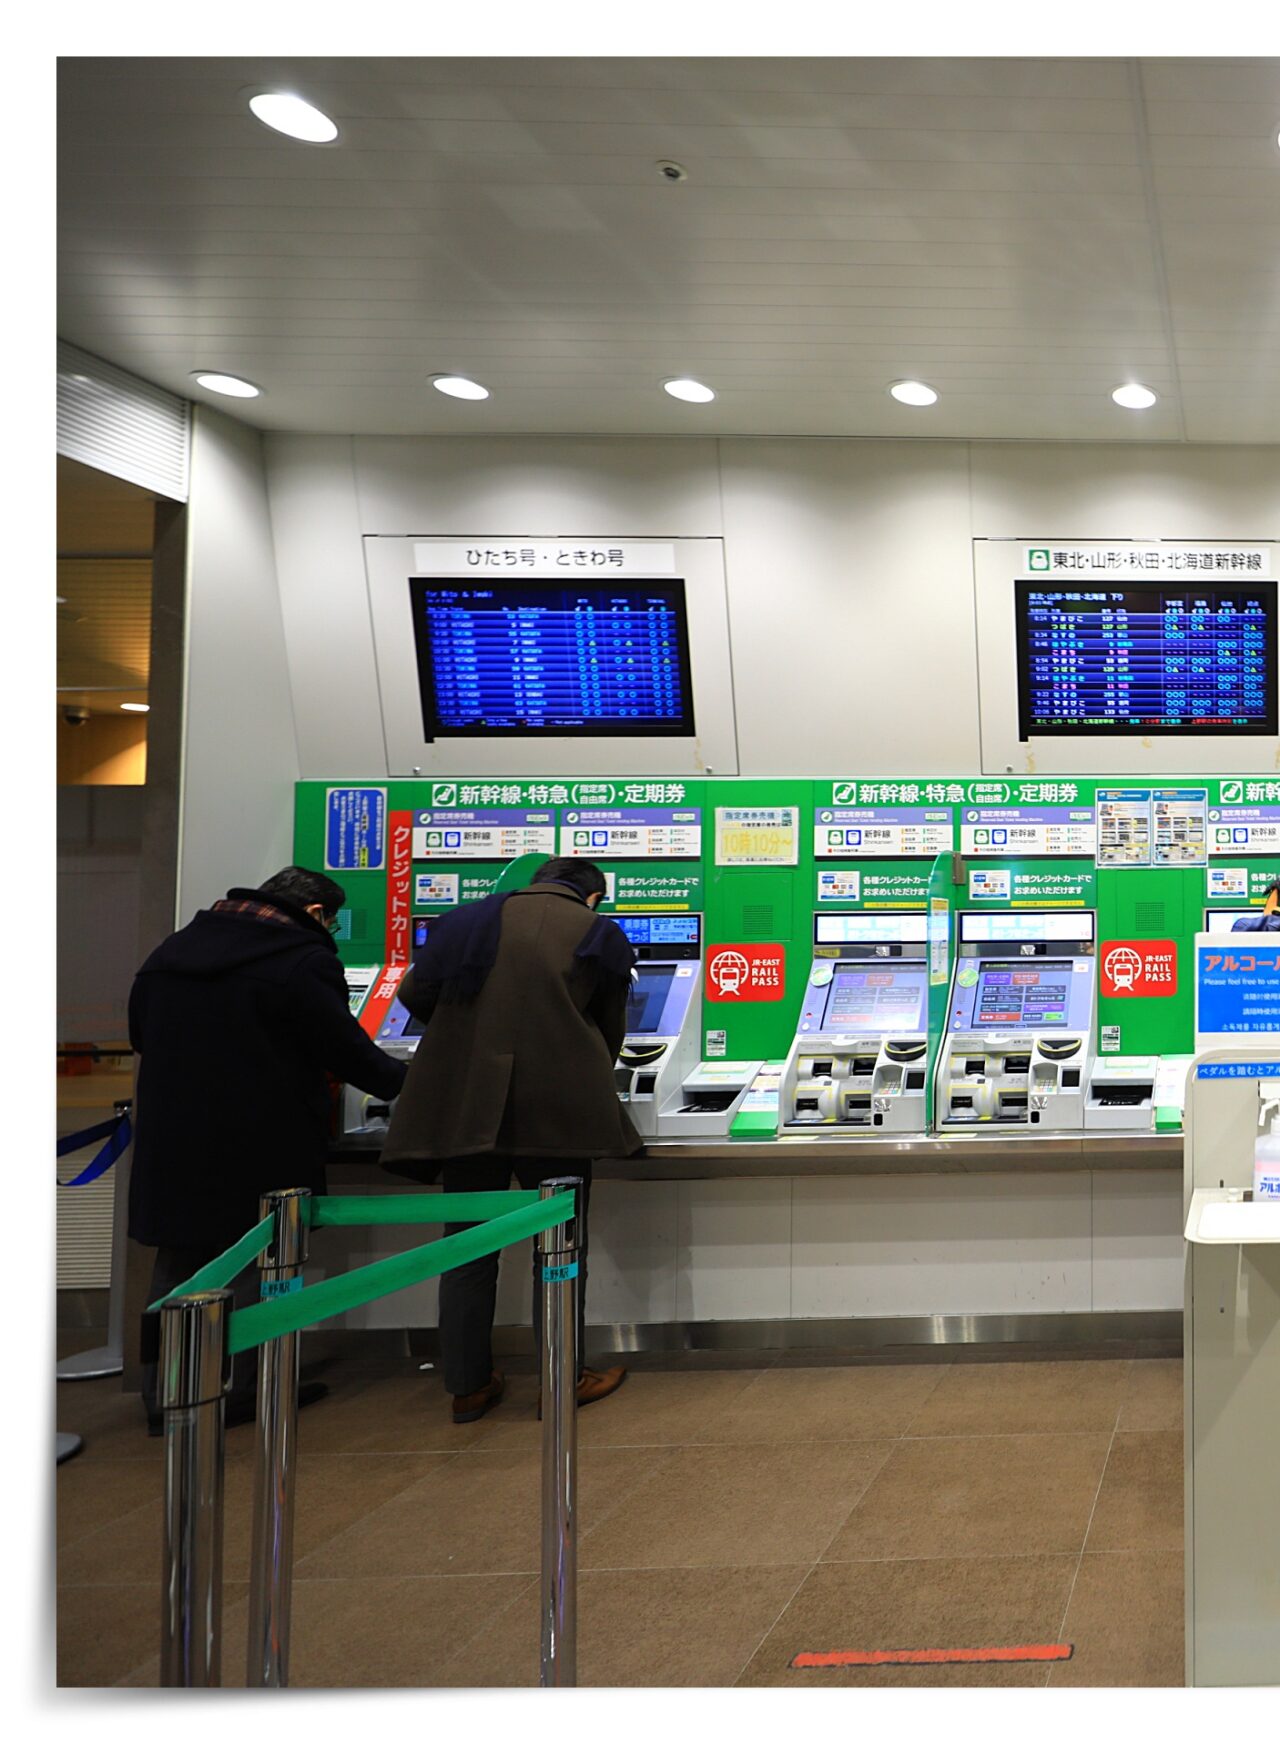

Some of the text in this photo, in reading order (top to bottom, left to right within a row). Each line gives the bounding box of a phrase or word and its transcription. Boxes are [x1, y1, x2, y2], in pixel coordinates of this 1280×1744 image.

[466, 549, 625, 567] ひたち号・ときわ号
[1053, 550, 1262, 571] 東北・山形・秋田・北海道新幹線
[579, 784, 608, 794] 指定席
[975, 783, 1003, 793] 指定席
[579, 795, 608, 804] 自由席
[975, 794, 1003, 803] 自由席
[464, 832, 490, 840] 新幹線
[611, 830, 638, 840] 新幹線
[864, 830, 891, 838] 新幹線
[1010, 828, 1036, 838] 新幹線
[1250, 828, 1276, 836] 新幹線
[618, 877, 700, 886] 各種クレジットカードで
[863, 876, 930, 885] 各種クレジットカー
[1014, 874, 1092, 883] 各種クレジットカードで
[618, 888, 689, 898] お求めいただけます
[1014, 886, 1082, 894] お求めいただけます
[374, 825, 410, 1000] クレジットカード専用
[752, 958, 780, 967] JR-EAST
[752, 968, 779, 977] RAIL
[1144, 964, 1171, 972] RAIL
[752, 977, 780, 986] PASS
[1144, 973, 1172, 982] PASS
[1204, 978, 1226, 986] Please
[1228, 978, 1240, 986] feel
[1242, 978, 1256, 986] free
[1258, 978, 1266, 986] to
[1267, 978, 1279, 986] use
